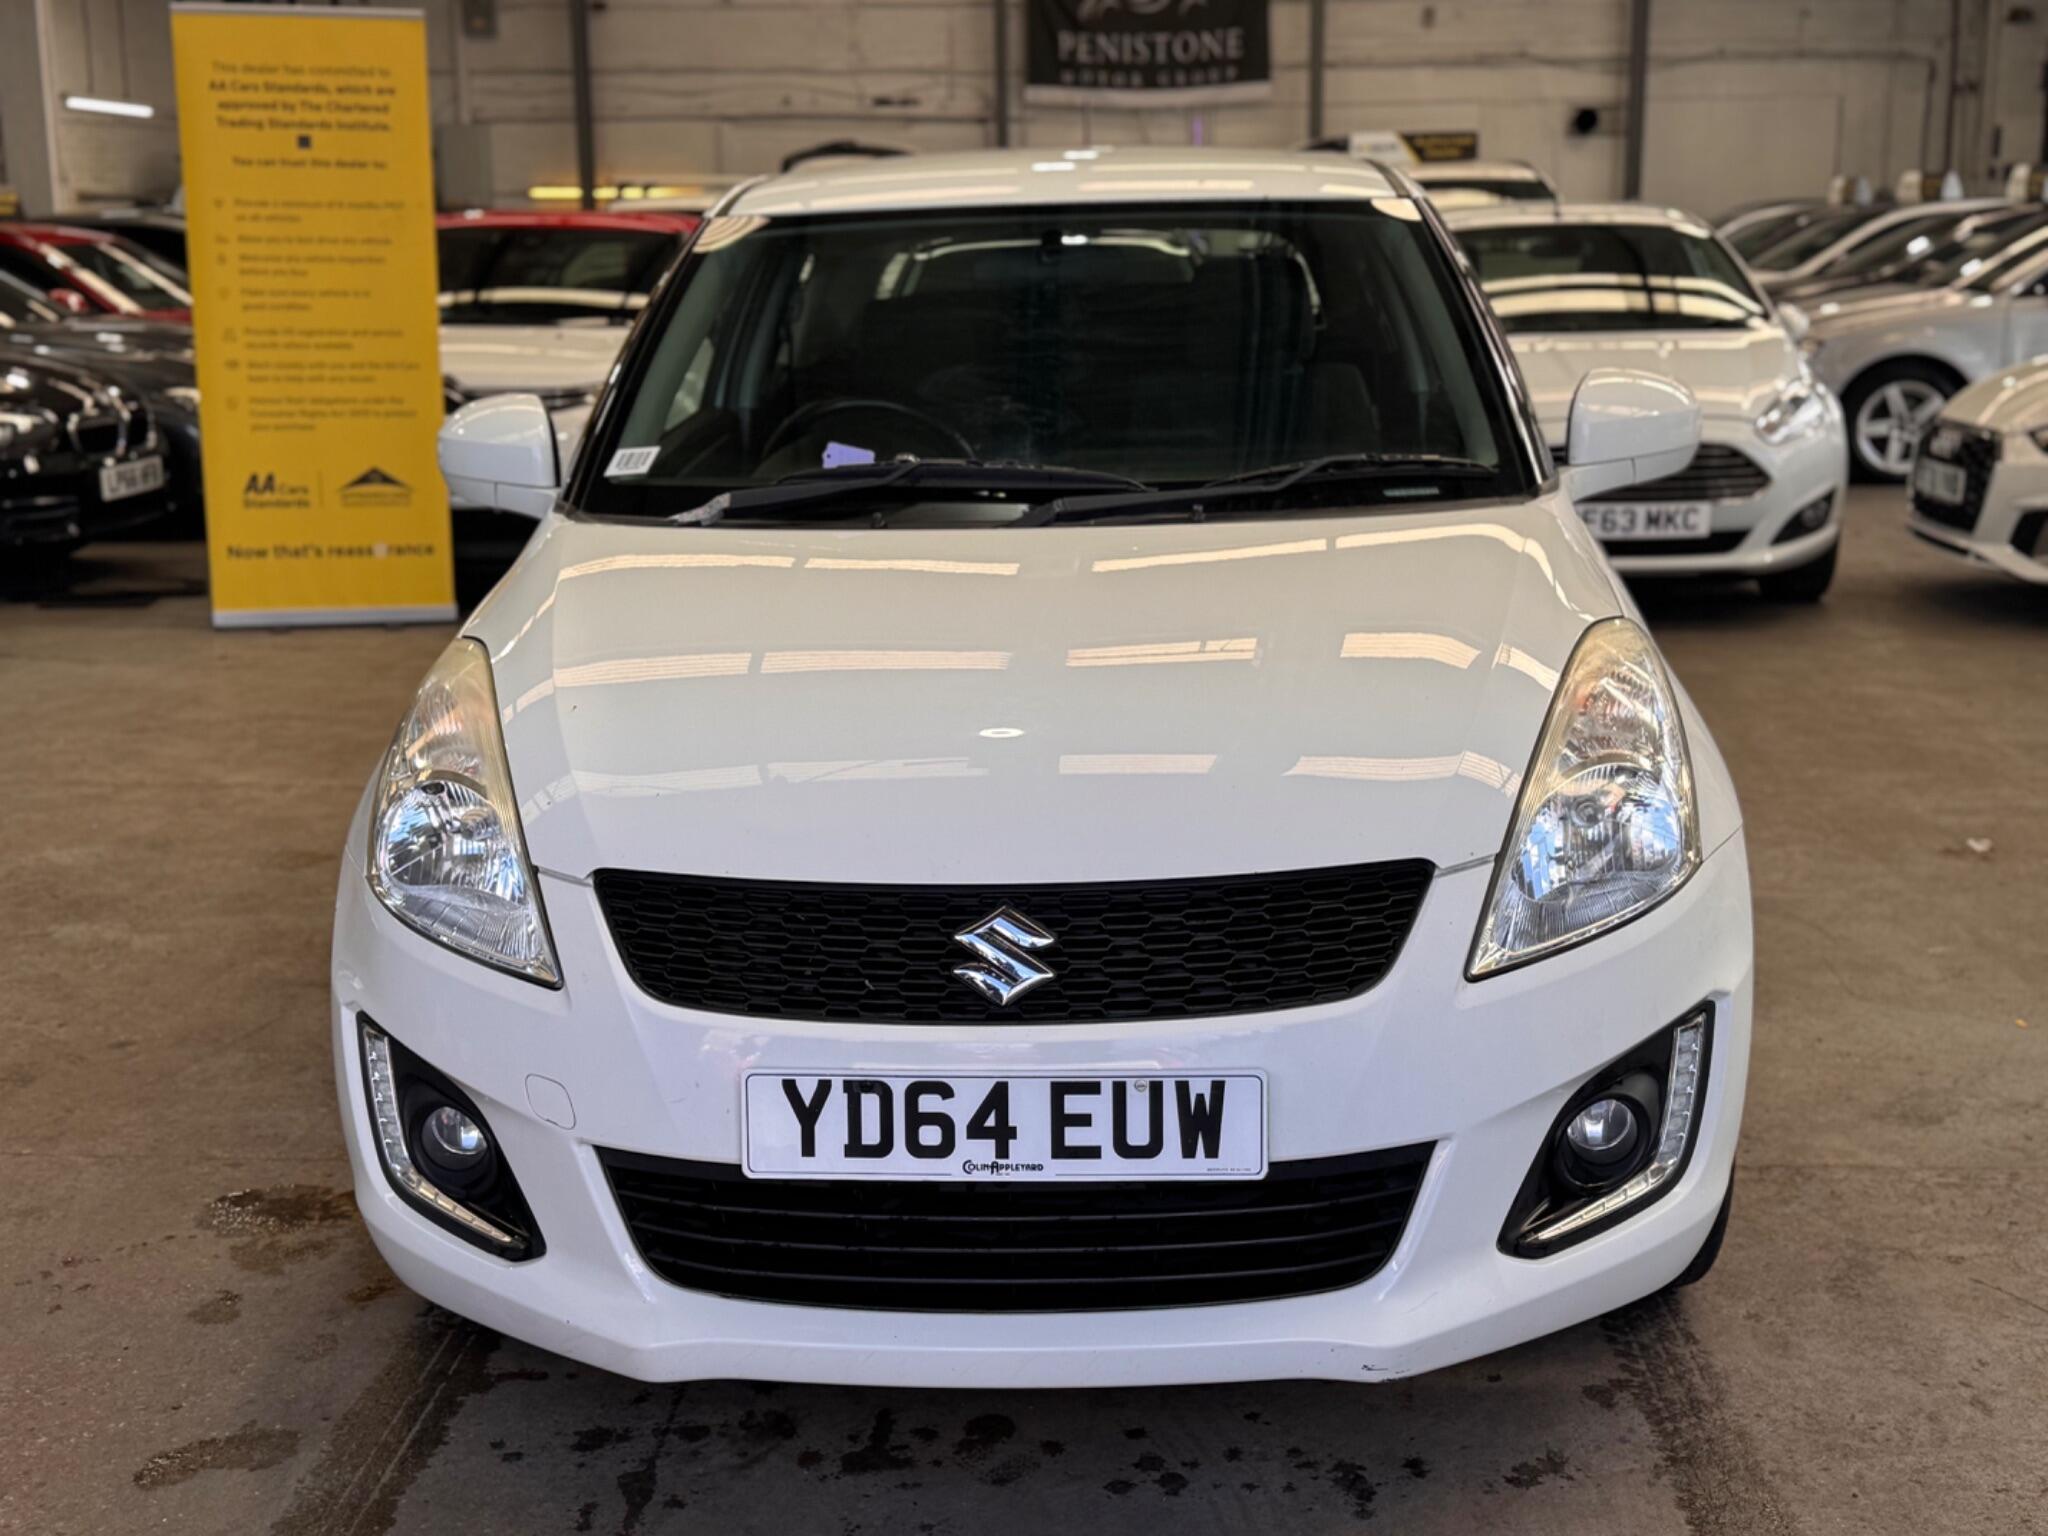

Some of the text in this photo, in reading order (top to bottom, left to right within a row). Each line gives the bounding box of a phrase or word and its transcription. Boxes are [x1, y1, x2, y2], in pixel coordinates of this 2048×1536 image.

[1057, 27, 1244, 65] PENISTONE
[244, 471, 276, 494] AA
[1645, 507, 1699, 530] MKC
[227, 542, 435, 559] Now that's reassrance
[781, 1079, 1227, 1160] YD64 EUW
